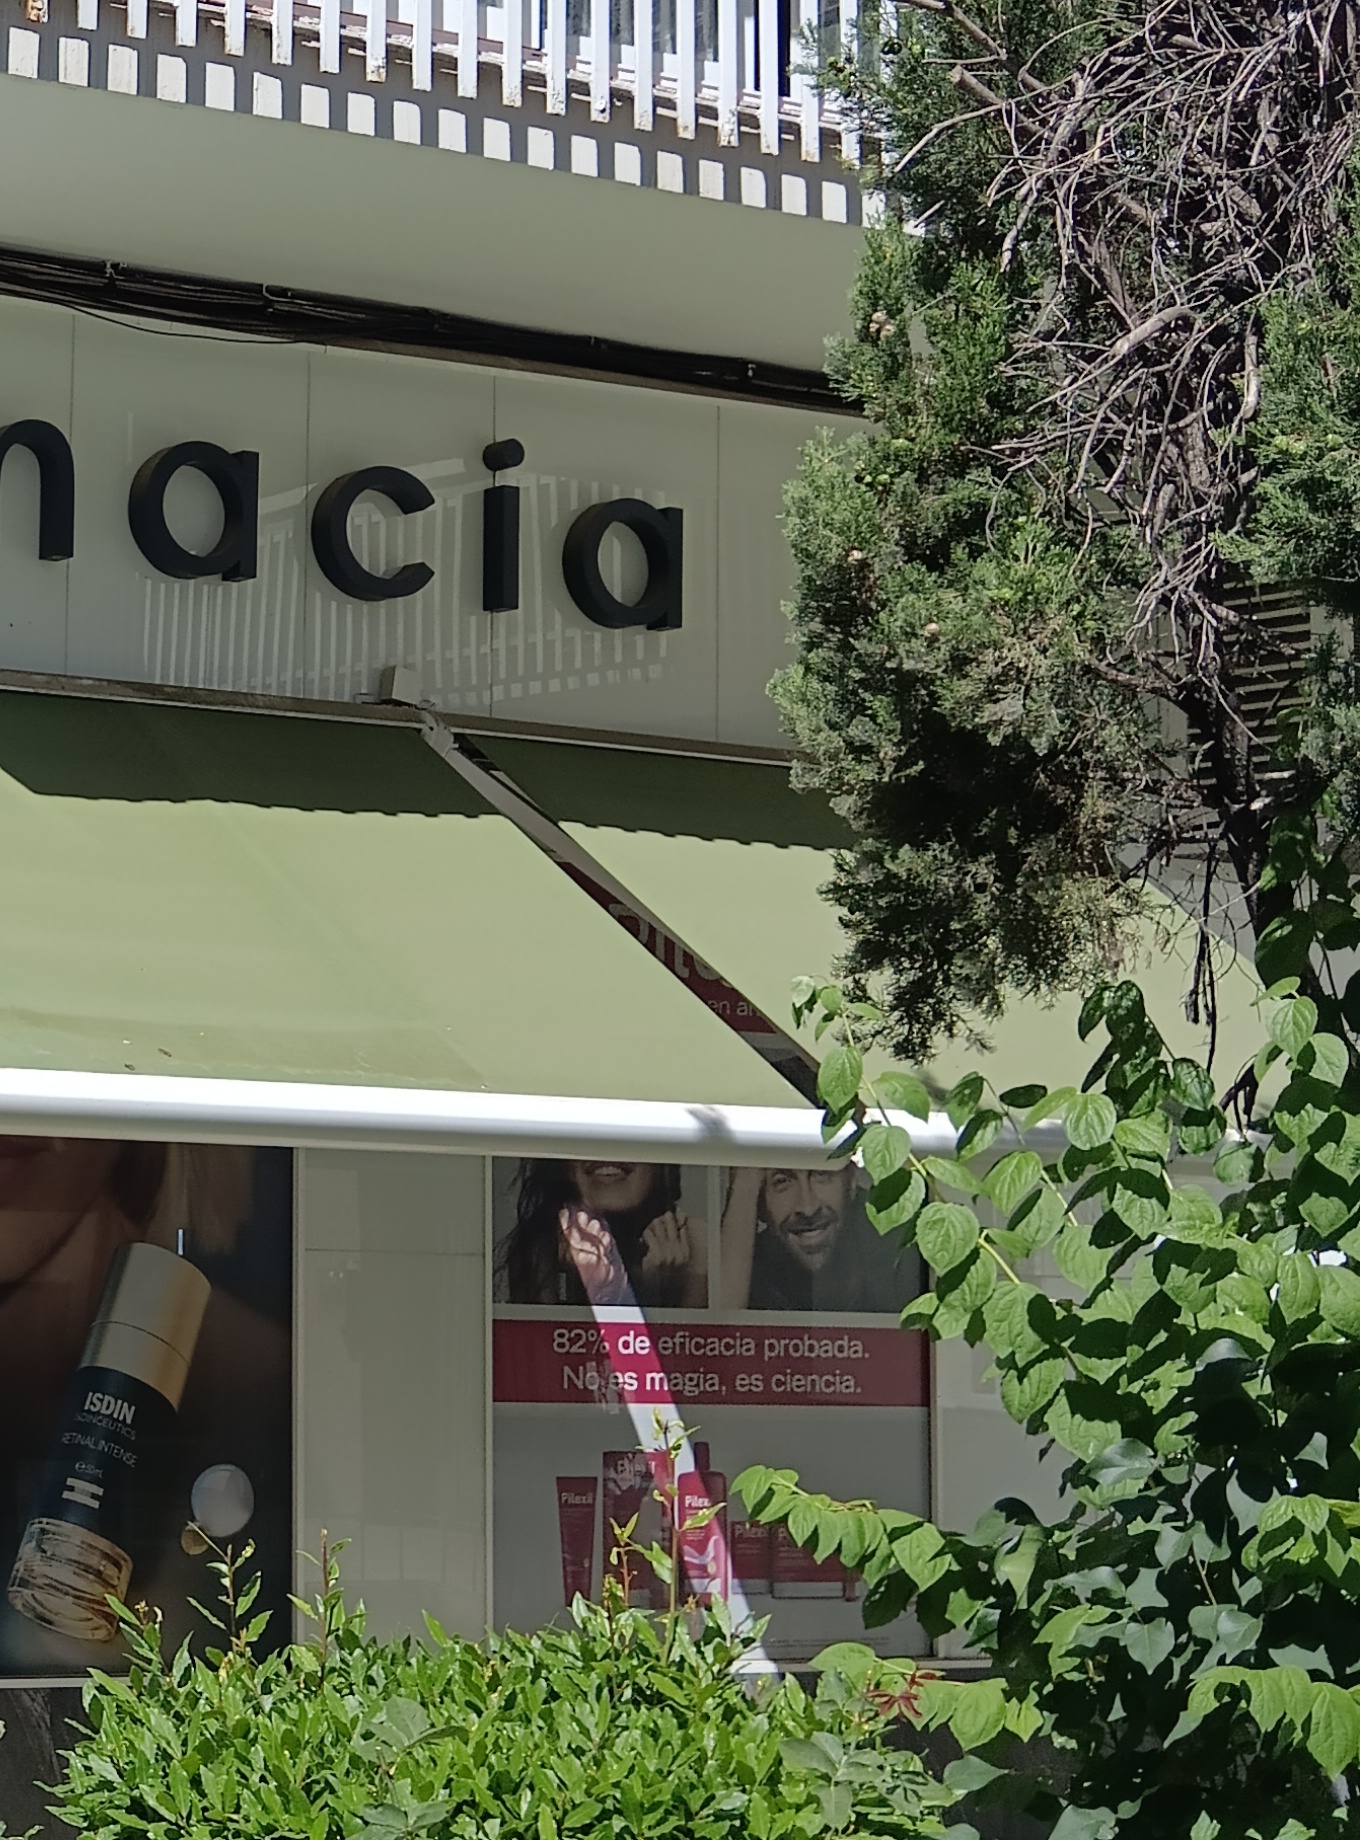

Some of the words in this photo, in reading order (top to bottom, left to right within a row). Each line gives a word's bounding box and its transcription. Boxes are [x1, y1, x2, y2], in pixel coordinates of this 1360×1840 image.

[552, 1328, 609, 1354] 82%
[617, 1330, 650, 1355] de
[657, 1332, 755, 1357] eficacia
[763, 1334, 870, 1361] probada.
[563, 1365, 600, 1390] No
[609, 1371, 639, 1391] es
[645, 1370, 727, 1396] magia,
[734, 1374, 764, 1392] es
[771, 1369, 862, 1394] ciencia.
[84, 1391, 136, 1425] ISDIN
[560, 1492, 593, 1505] Pilexil
[684, 1495, 712, 1508] Pilex
